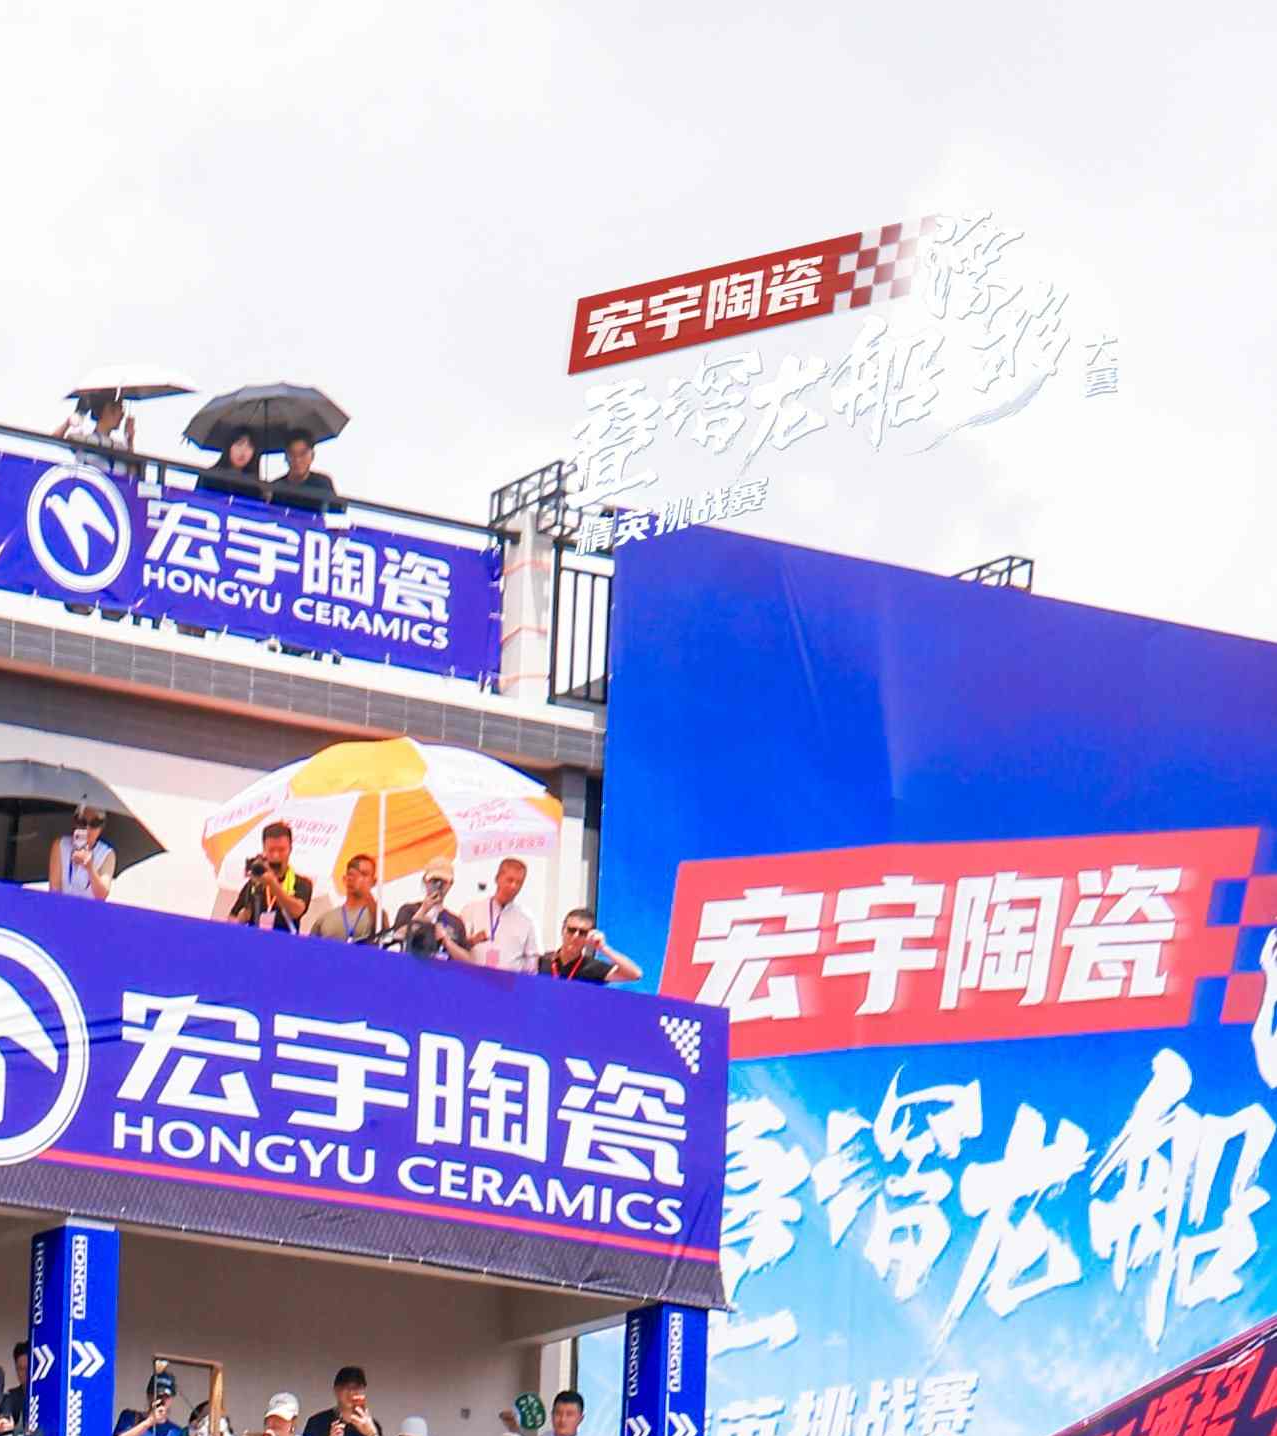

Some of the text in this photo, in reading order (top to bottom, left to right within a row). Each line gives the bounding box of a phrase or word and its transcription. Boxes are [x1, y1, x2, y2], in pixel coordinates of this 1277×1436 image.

[143, 563, 450, 651] HONGYU CERAMICS
[145, 501, 450, 624] 宏宇陶瓷
[693, 864, 1183, 1024] 宏宇陶瓷
[117, 991, 688, 1186] 宏宇陶瓷
[113, 1111, 685, 1236] HONGYU CERAMICS
[31, 1240, 45, 1326] HONGYU
[70, 1234, 89, 1321] HONGYU
[668, 1312, 684, 1393] HONGYU
